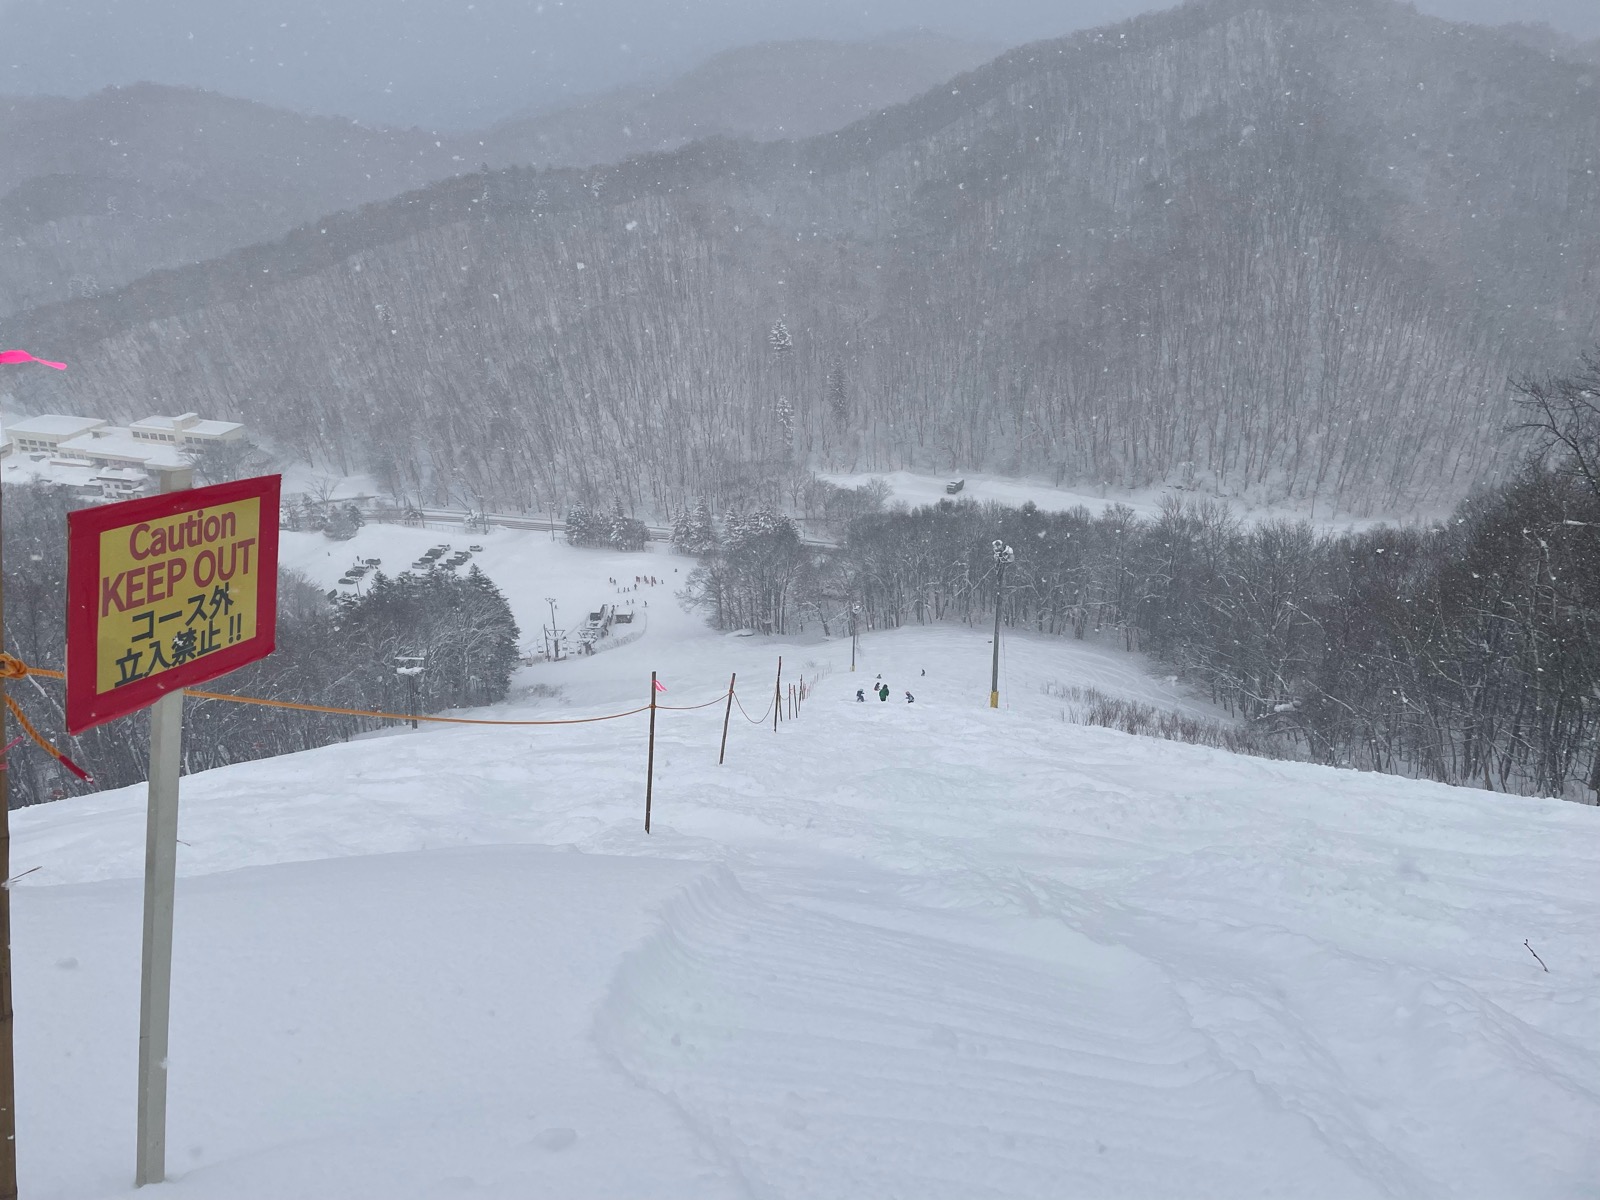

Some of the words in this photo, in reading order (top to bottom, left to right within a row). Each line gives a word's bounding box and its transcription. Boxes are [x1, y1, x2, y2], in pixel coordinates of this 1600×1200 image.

[129, 509, 236, 561] Caution
[101, 557, 187, 618] KEEP
[193, 538, 256, 588] OUT
[131, 581, 234, 643] コース外
